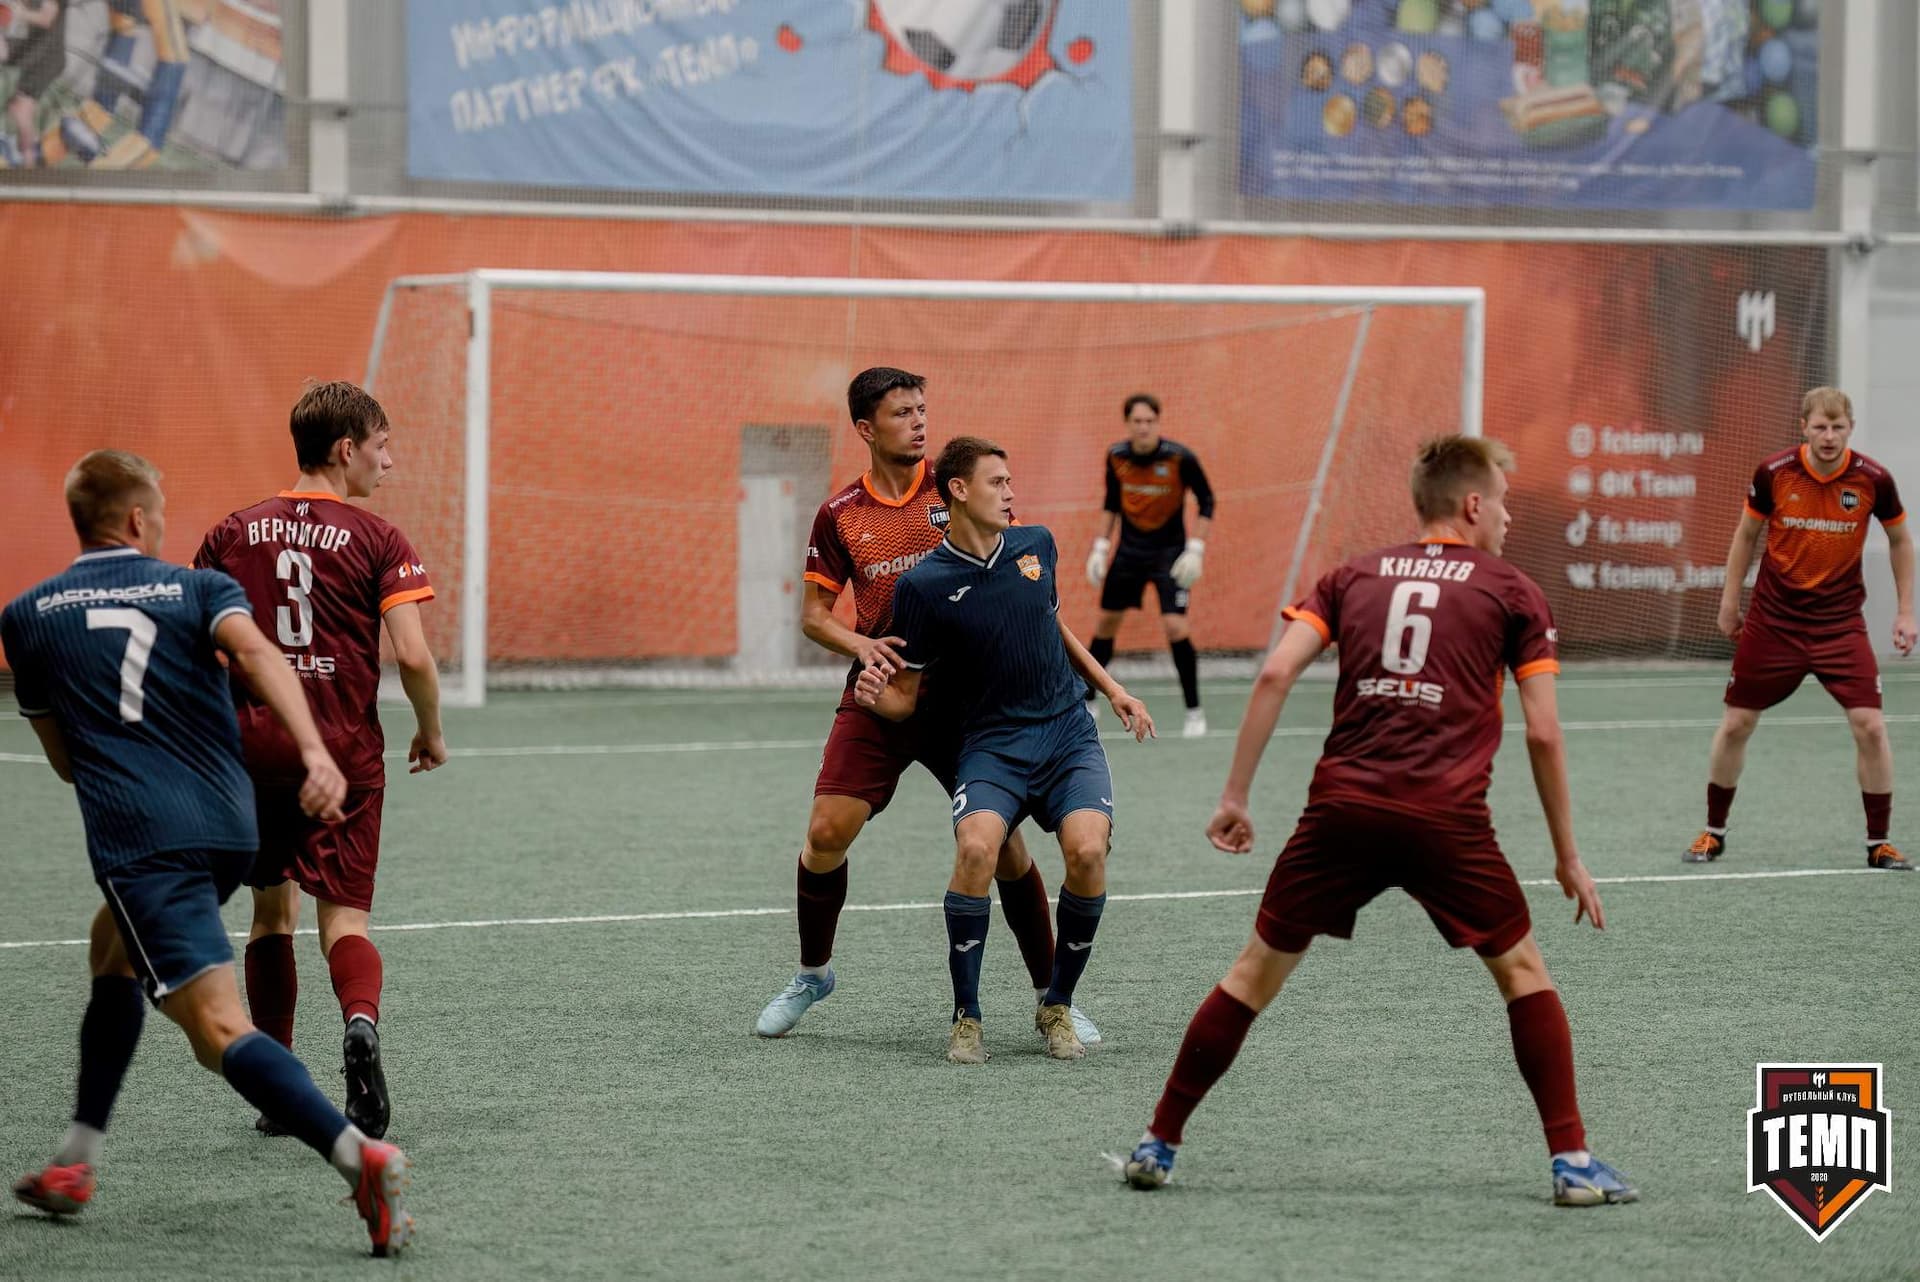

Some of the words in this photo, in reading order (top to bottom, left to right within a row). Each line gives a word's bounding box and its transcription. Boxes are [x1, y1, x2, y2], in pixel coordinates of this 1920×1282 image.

[450, 66, 587, 132] ПАРТНЕР
[1601, 425, 1704, 459] fctemp.ru
[1600, 470, 1636, 497] ФК
[1640, 469, 1697, 498] Темп
[247, 517, 352, 553] ВЕРНИГОР
[1598, 514, 1682, 548] fc.temp
[1379, 557, 1475, 583] КНЯЗЕВ
[276, 548, 314, 647] 3
[1381, 581, 1440, 676] 6
[86, 608, 158, 723] 7
[1357, 677, 1445, 704] SEUS
